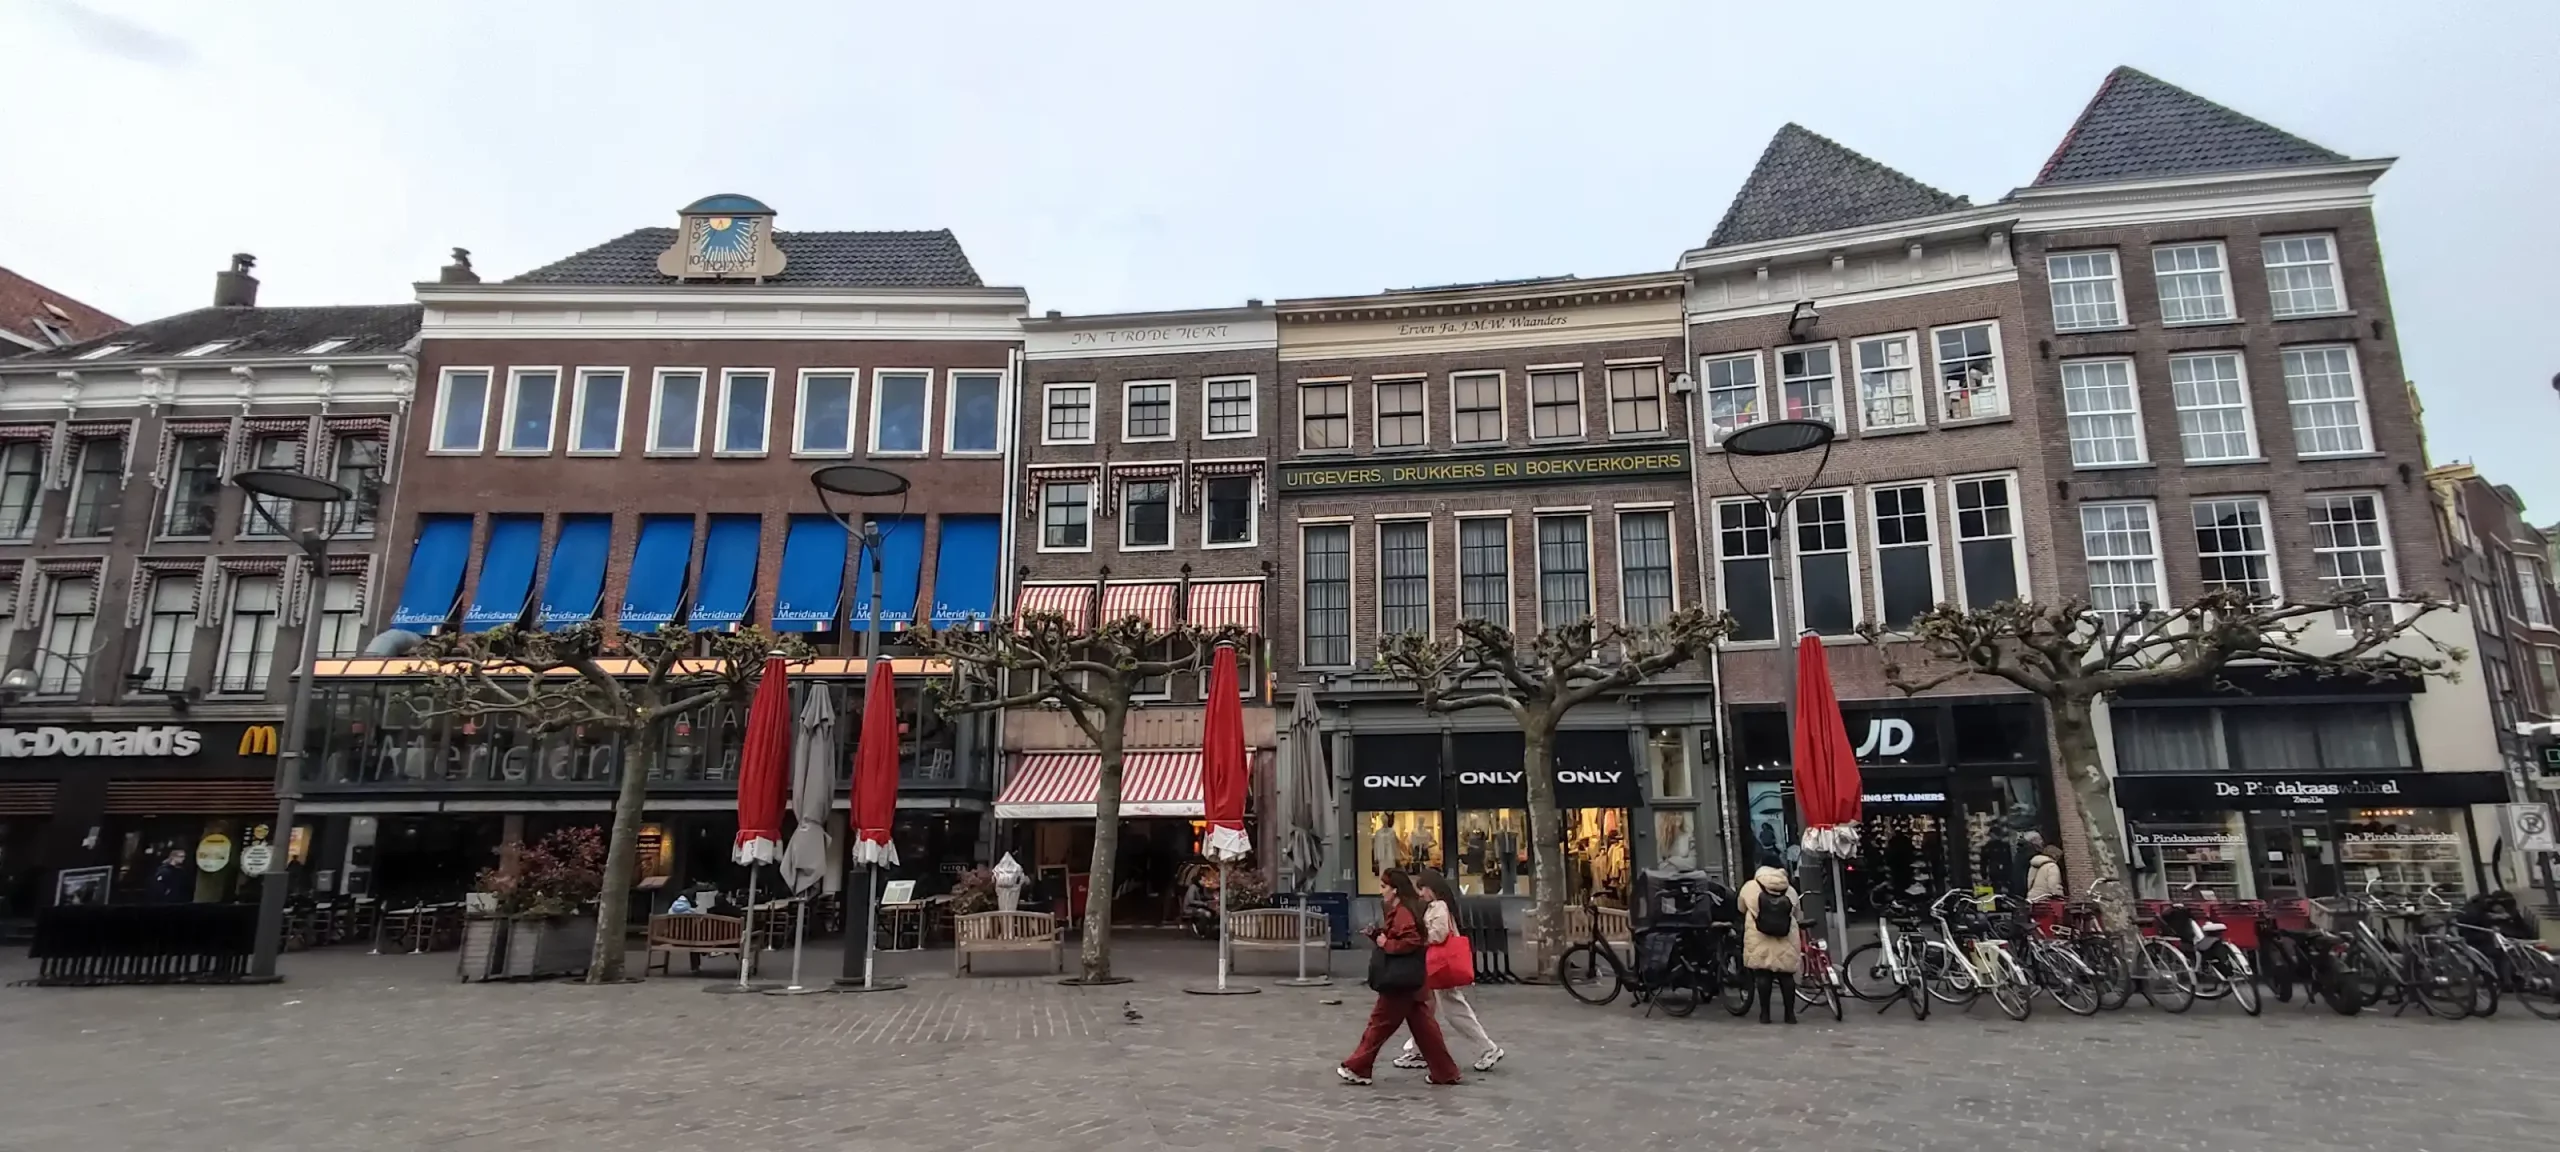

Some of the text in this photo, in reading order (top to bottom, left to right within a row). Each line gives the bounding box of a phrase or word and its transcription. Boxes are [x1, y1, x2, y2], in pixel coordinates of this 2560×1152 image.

[1398, 315, 1568, 336] Erven Fa. J.M.W. Waanders
[1071, 332, 1098, 345] IN
[1121, 329, 1171, 342] RODE
[1176, 325, 1229, 339] HERT
[1286, 453, 1682, 487] UITGEVERS, DRUKKERS EN BOEKVERKOPERS
[398, 605, 409, 613] La
[470, 603, 482, 612] La
[540, 602, 552, 611] La
[622, 601, 634, 611] La
[693, 602, 705, 611] La
[779, 601, 790, 610] La
[858, 601, 869, 610] La
[937, 601, 948, 610] La
[394, 612, 445, 622] Meridiana
[465, 611, 518, 620] Meridiana
[620, 610, 673, 620] Meridiana
[690, 609, 743, 619] Meridiana
[777, 609, 829, 619] Meridiana
[856, 609, 907, 619] Mediana
[1856, 718, 1914, 757] JD
[1363, 775, 1427, 788] ONLY
[1459, 771, 1524, 785] ONLY
[1557, 771, 1622, 784] ONLY
[2214, 780, 2400, 796] De Pindakaaswinkel
[1893, 793, 1946, 802] TRAINERS
[2292, 796, 2325, 804] Zwolle
[2135, 833, 2244, 843] De Pindakaaswinkel
[2344, 832, 2360, 841] De
[1280, 895, 1289, 905] La
